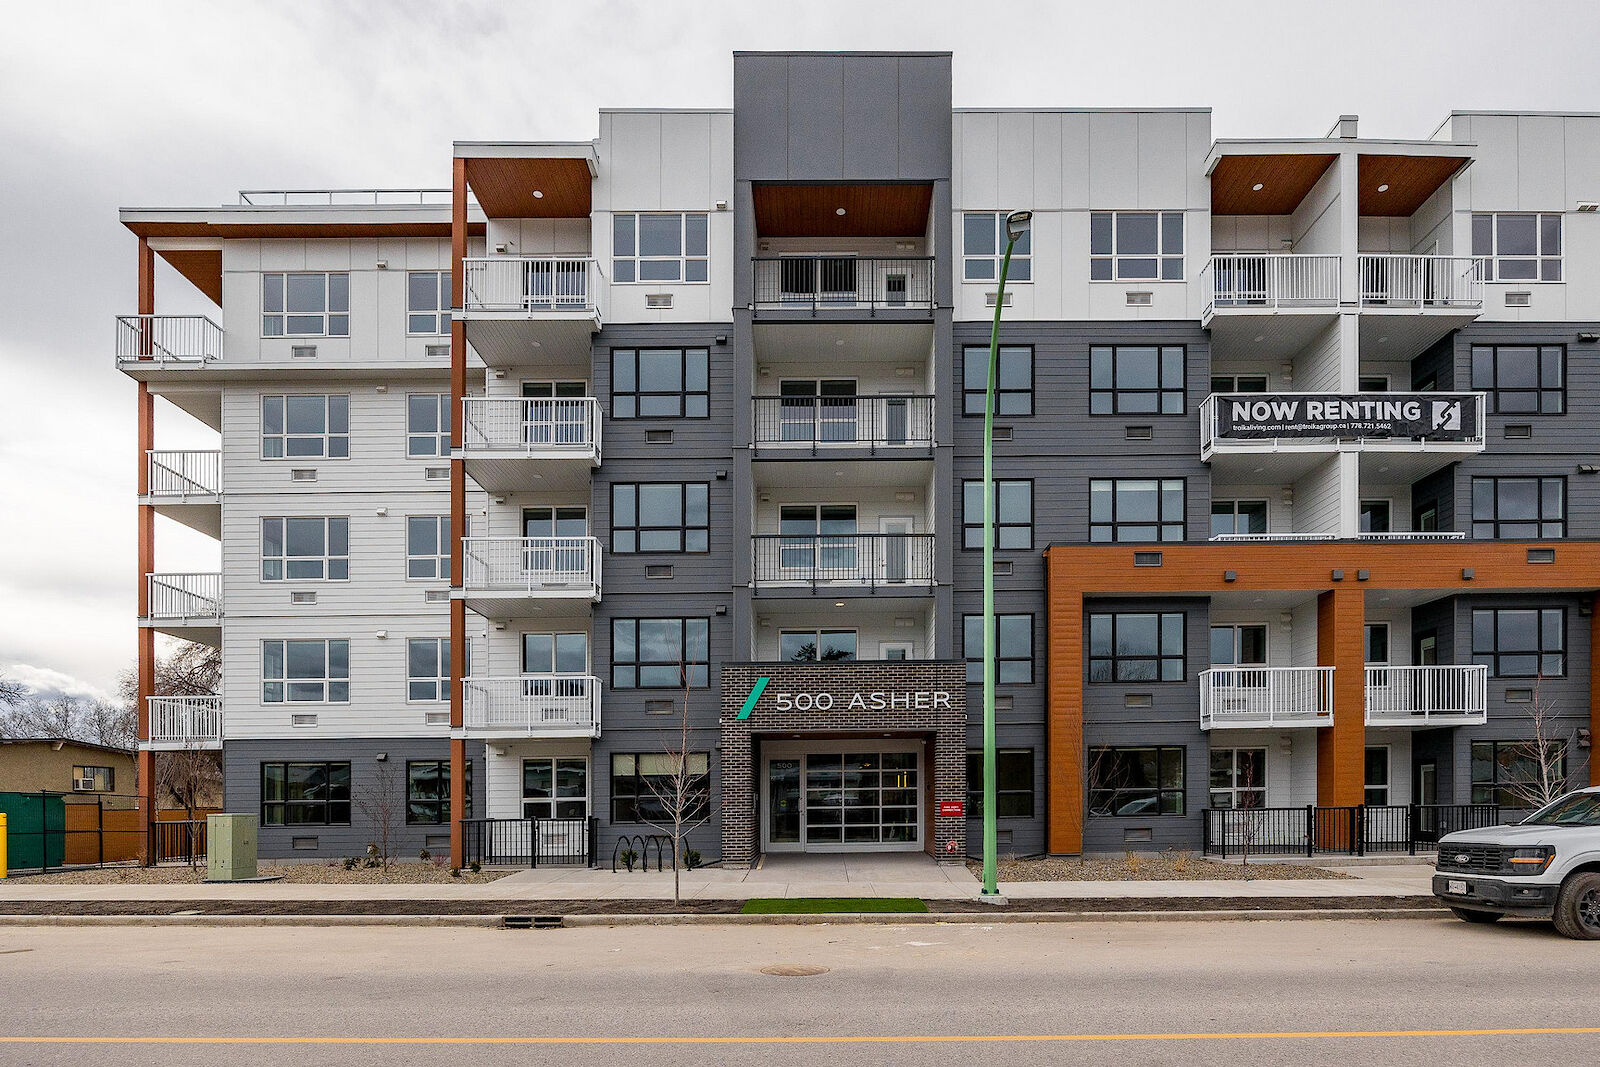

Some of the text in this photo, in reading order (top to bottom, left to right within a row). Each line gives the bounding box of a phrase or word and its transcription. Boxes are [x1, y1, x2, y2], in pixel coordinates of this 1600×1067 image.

[1232, 401, 1421, 422] NOW RENTING
[1232, 424, 1281, 432] troikaliving.com
[1285, 423, 1346, 431] rent@troikagroup.ca
[1351, 422, 1392, 430] 778.721.5462
[776, 691, 951, 711] 500 ASHER
